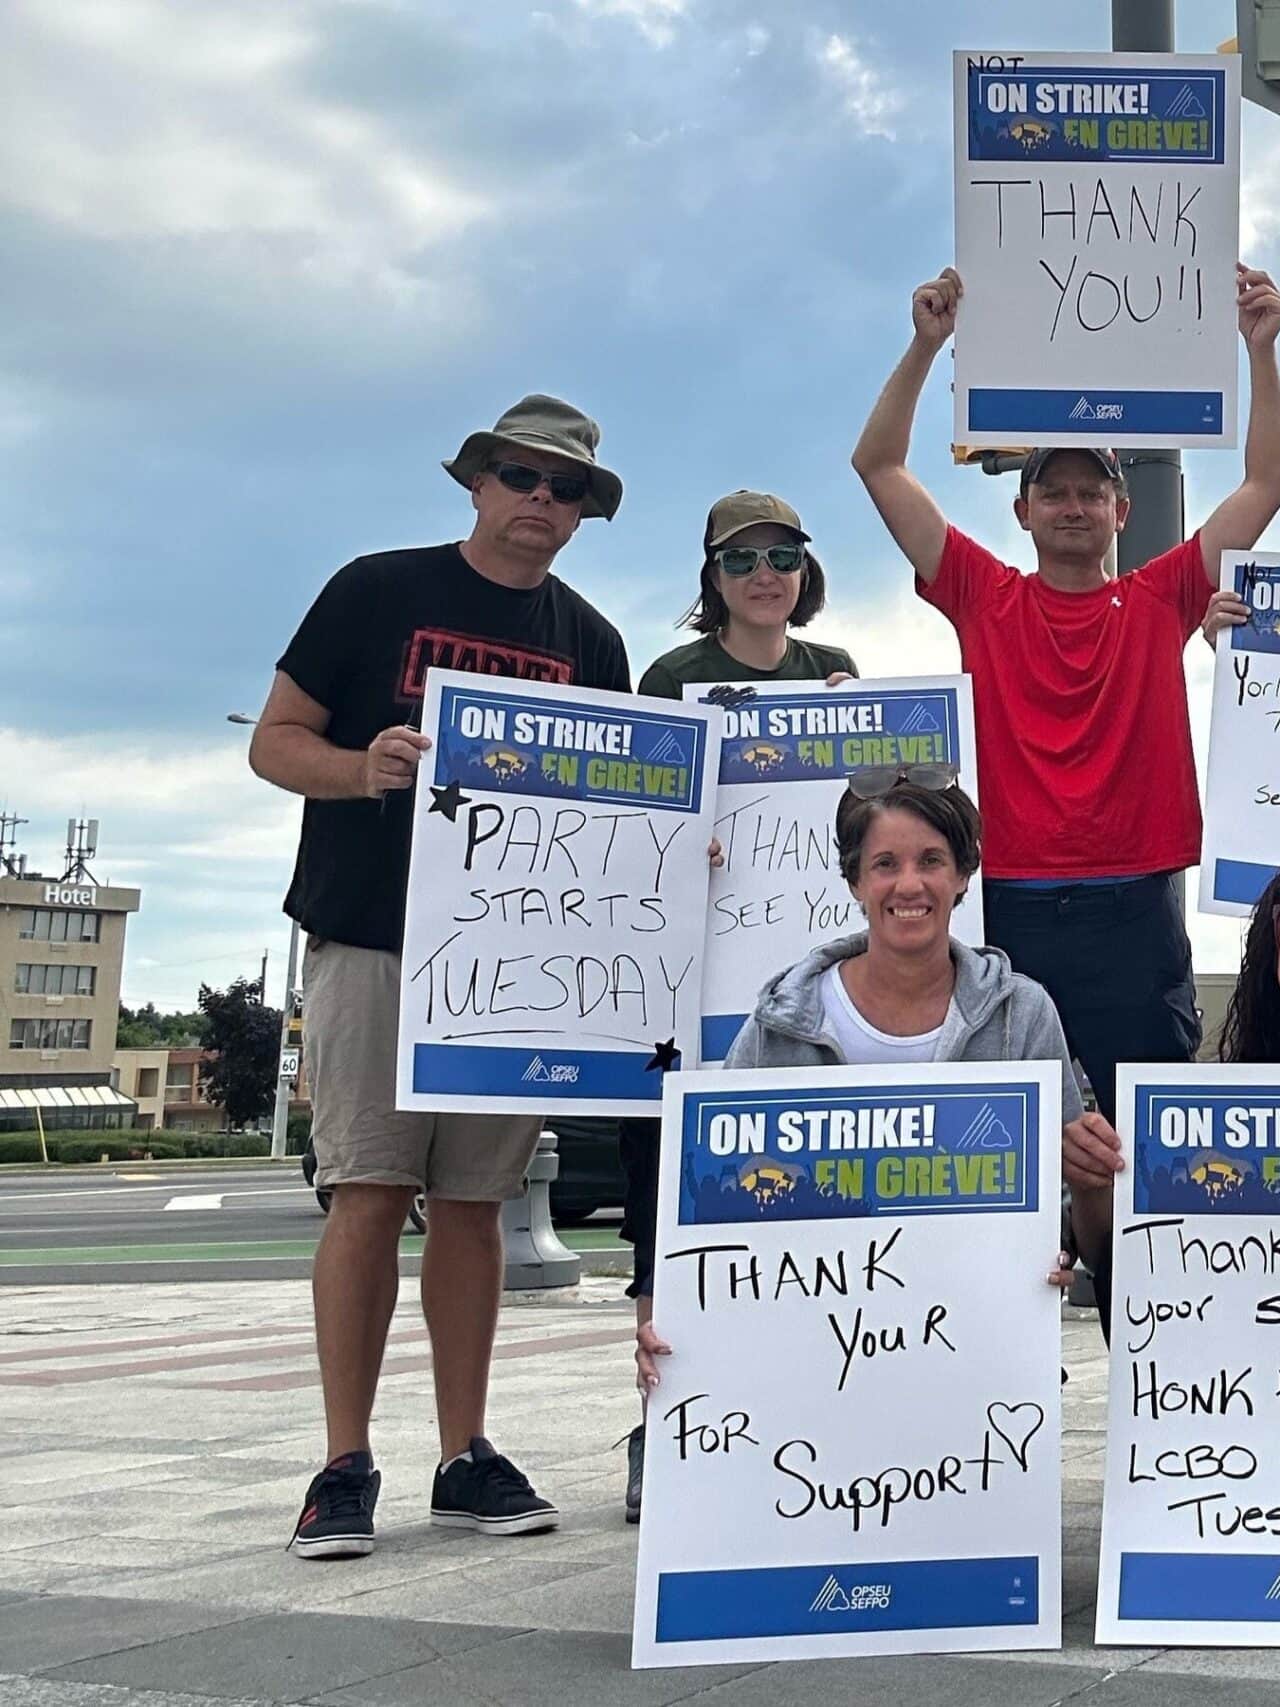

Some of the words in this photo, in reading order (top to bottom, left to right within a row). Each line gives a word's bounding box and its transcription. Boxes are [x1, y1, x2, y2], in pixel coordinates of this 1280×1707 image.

[967, 56, 1024, 75] NOT
[988, 83, 1027, 113] ON
[1036, 83, 1149, 114] STRIKE!
[1063, 119, 1099, 149] EN
[1107, 114, 1208, 152] GRÈVE!
[971, 178, 1202, 257] THANK
[1040, 255, 1203, 341] YOU!!
[460, 706, 504, 743] ON
[514, 714, 633, 755] STRIKE!
[724, 710, 759, 739] ON
[769, 704, 882, 736] STRIKE!
[797, 741, 834, 767] EN
[842, 730, 943, 767] GRÈVE!
[541, 752, 578, 788] EN
[587, 754, 687, 799] GRÈVE!
[464, 803, 685, 892] PARTY
[714, 795, 843, 872] THAN
[45, 885, 96, 906] Hotel
[454, 888, 666, 932] STARTS
[715, 894, 784, 935] SEE
[412, 932, 693, 1029] TUESDAY
[282, 1058, 297, 1072] 60
[709, 1111, 765, 1156] ON
[776, 1103, 935, 1153] STRIKE!
[1160, 1107, 1213, 1148] ON
[815, 1158, 864, 1200] EN
[875, 1144, 1016, 1199] GRÈVE!
[664, 1227, 905, 1311] THANK
[1127, 1295, 1213, 1353] your
[1132, 1361, 1253, 1419] HONK
[1129, 1444, 1257, 1483] LCBO
[850, 1597, 890, 1610] SEFPO
[851, 1585, 892, 1598] OPSEU
